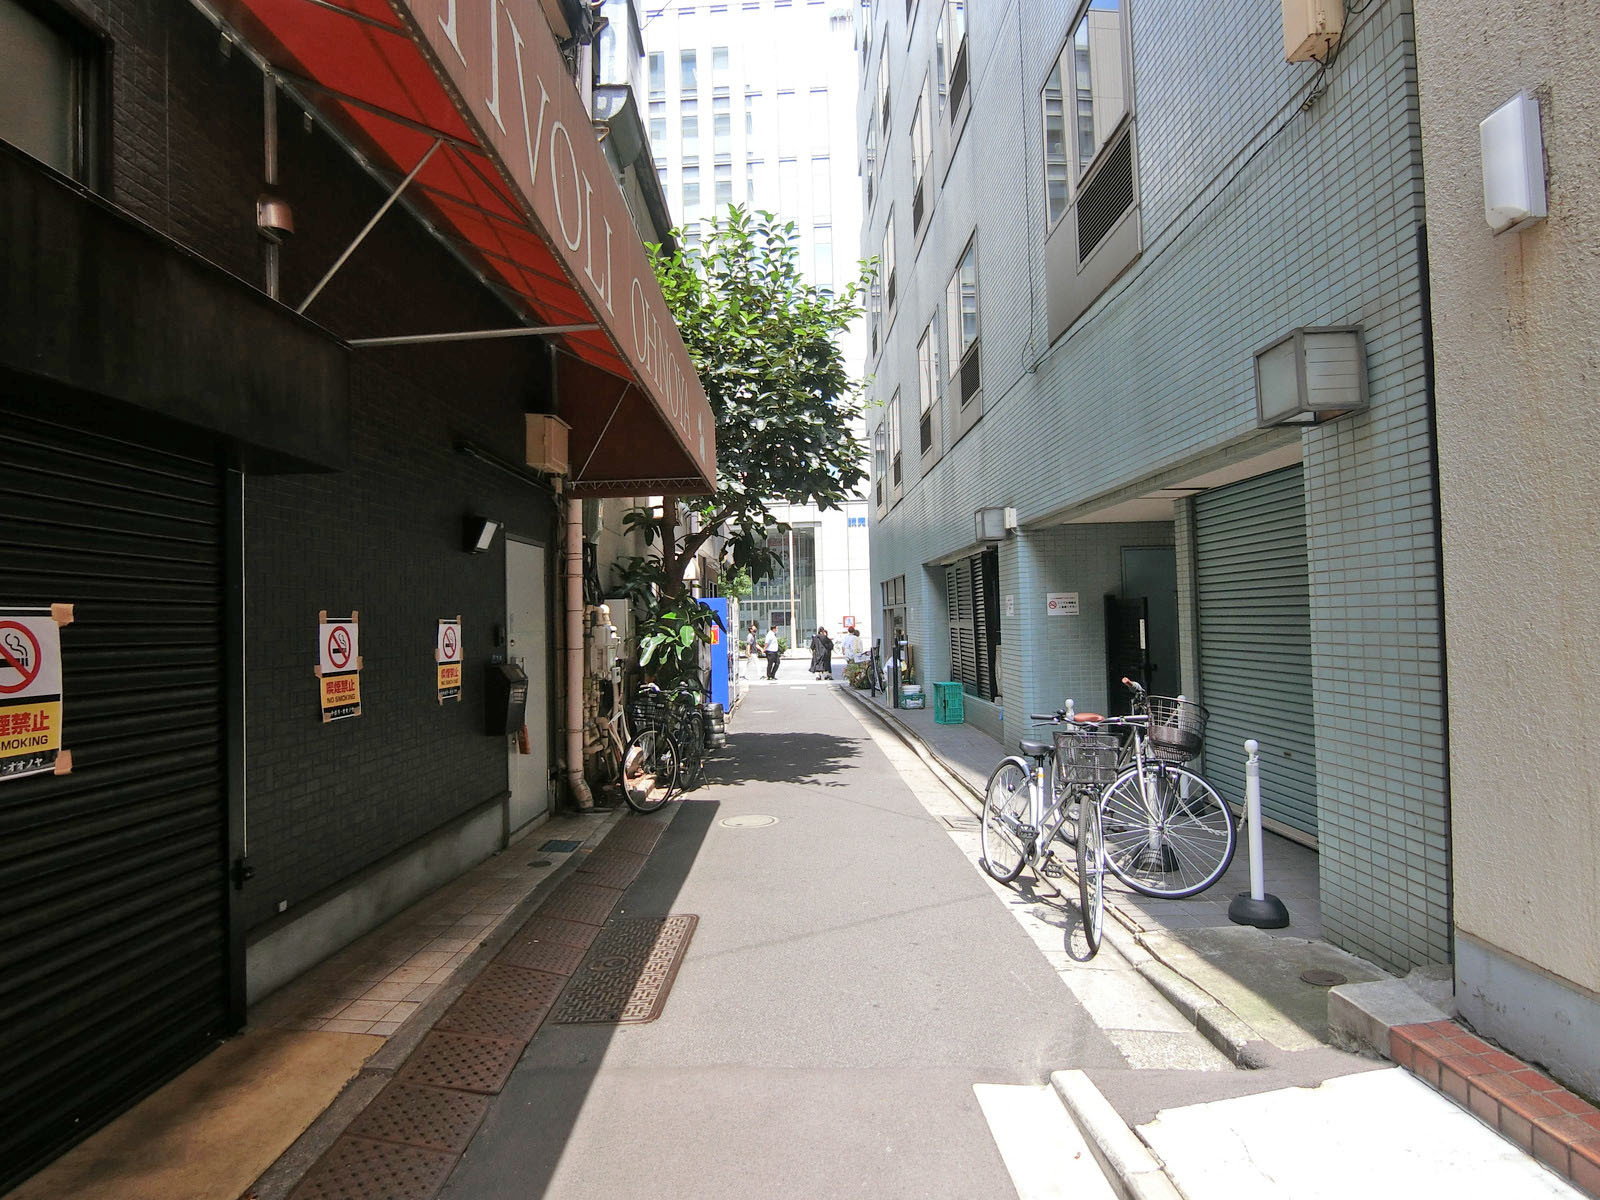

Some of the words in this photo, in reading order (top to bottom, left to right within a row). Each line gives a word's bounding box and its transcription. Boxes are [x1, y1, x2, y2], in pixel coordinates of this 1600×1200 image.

[631, 277, 692, 441] OHNOYA
[326, 679, 356, 694] 喫煙禁止
[335, 694, 356, 703] SMOKING
